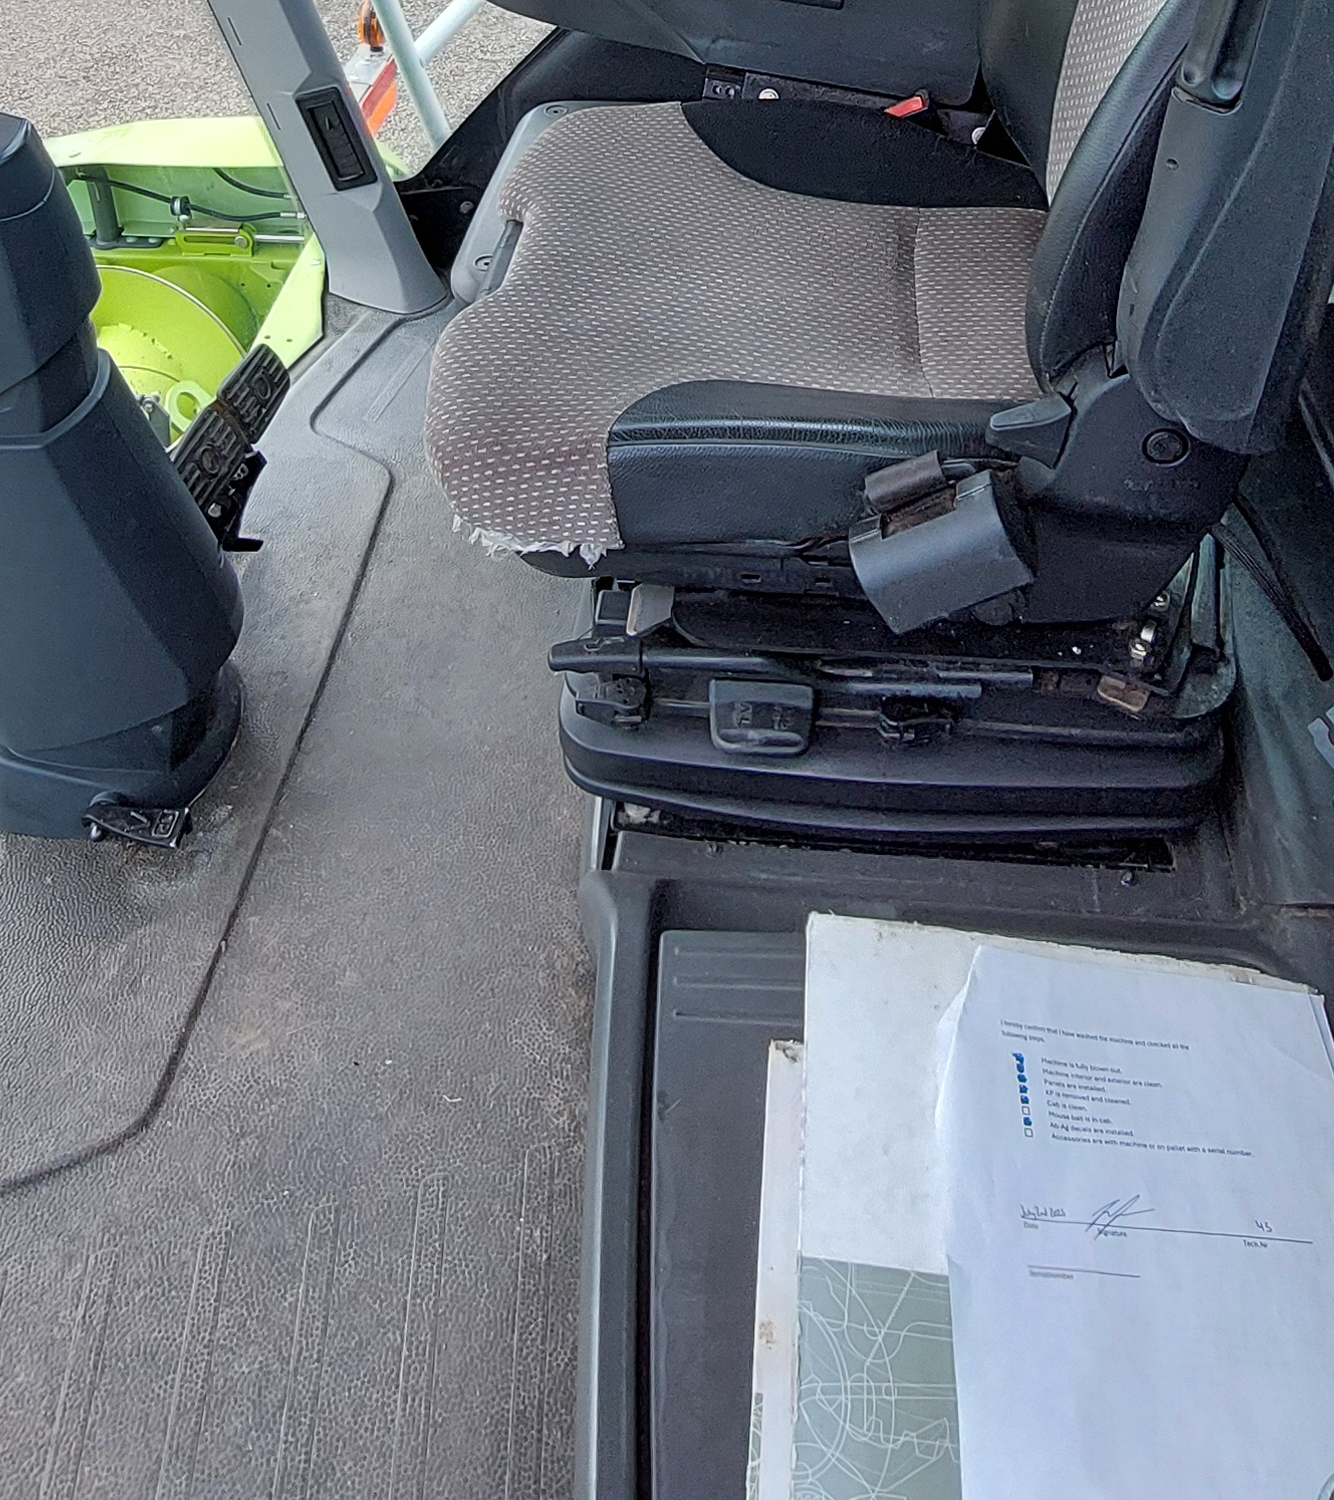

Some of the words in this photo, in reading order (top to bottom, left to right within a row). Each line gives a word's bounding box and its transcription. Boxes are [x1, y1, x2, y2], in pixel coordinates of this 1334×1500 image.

[1062, 1029, 1075, 1037] have
[1076, 1032, 1099, 1040] washed
[1099, 1034, 1108, 1042] the
[1109, 1036, 1134, 1045] machine
[1134, 1039, 1146, 1047] and
[1147, 1040, 1171, 1049] checked
[1041, 1057, 1067, 1067] Machine
[1075, 1062, 1089, 1071] fully
[1042, 1068, 1069, 1078] Machine
[1071, 1073, 1093, 1081] interior
[1107, 1077, 1131, 1085] exterior
[1044, 1078, 1065, 1088] Panels
[1061, 1092, 1090, 1101] removed
[1047, 1100, 1060, 1108] Cab
[1048, 1110, 1070, 1120] Mouse
[1051, 1133, 1091, 1144] Accessories
[1092, 1137, 1103, 1145] are
[1104, 1138, 1118, 1147] with
[1119, 1140, 1148, 1149] machine
[1166, 1143, 1186, 1154] pallet
[1186, 1145, 1201, 1153] with
[1207, 1146, 1226, 1155] serial
